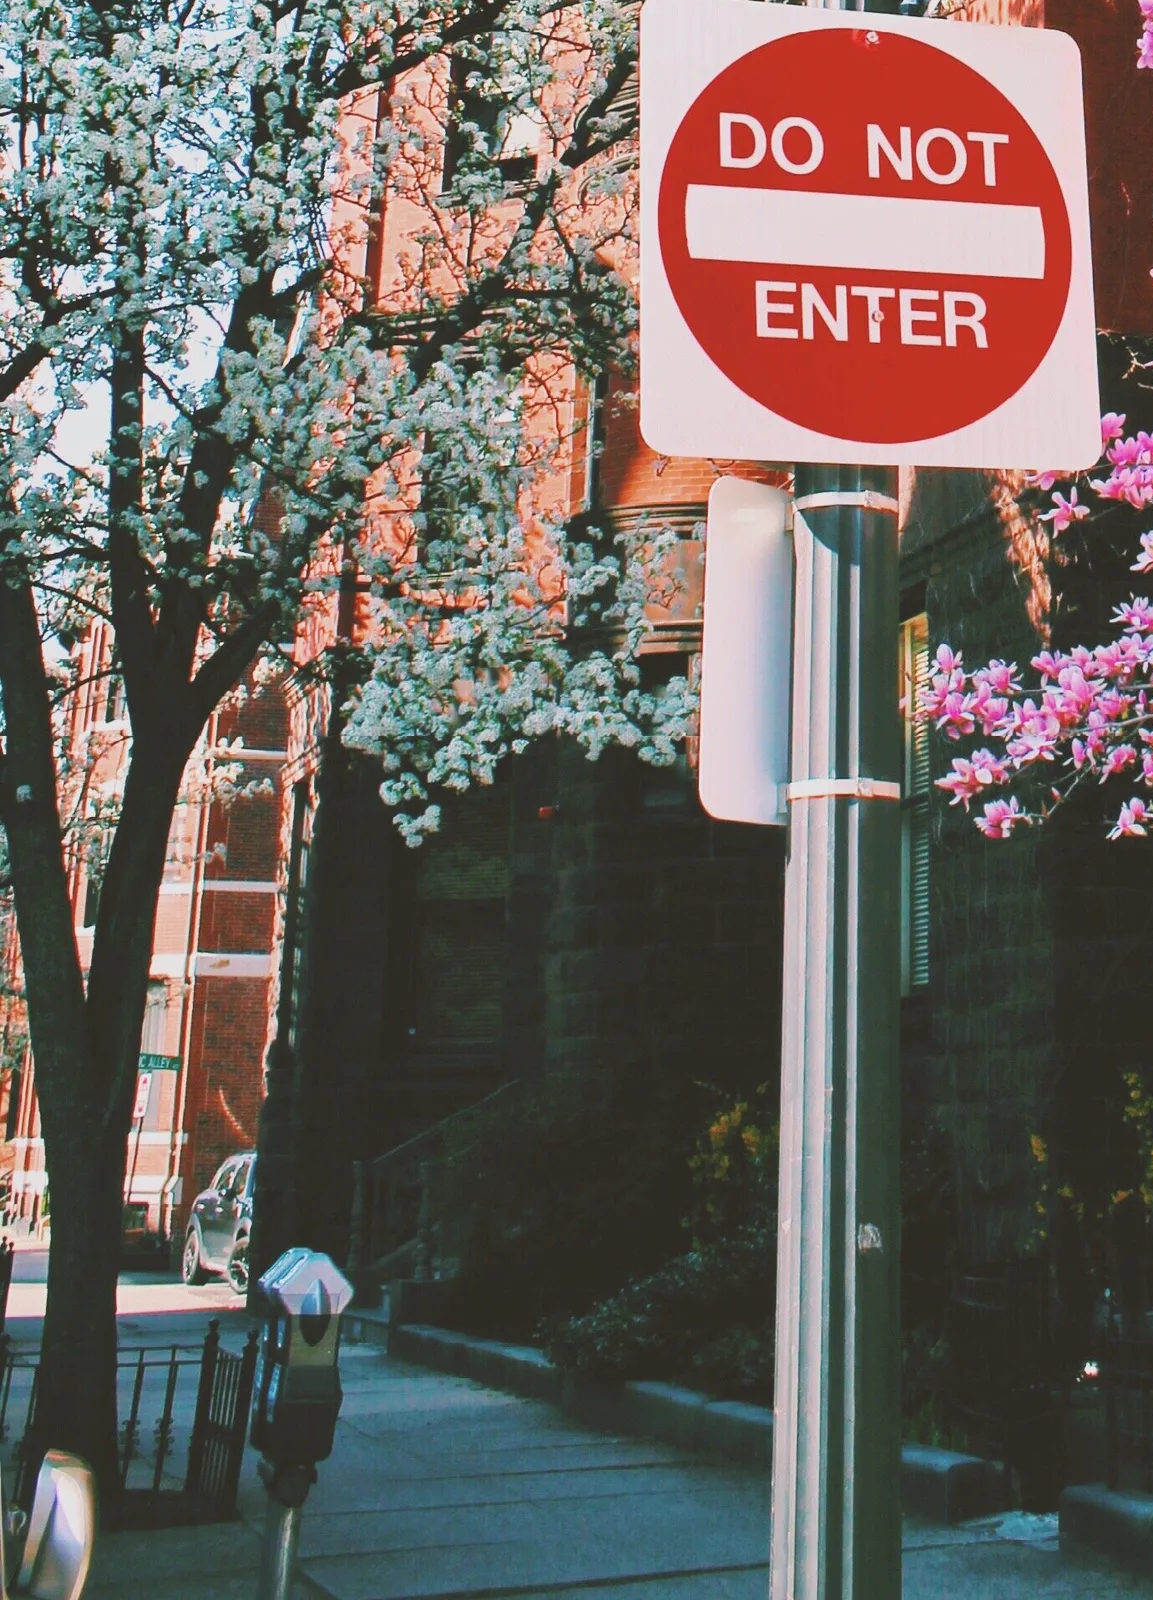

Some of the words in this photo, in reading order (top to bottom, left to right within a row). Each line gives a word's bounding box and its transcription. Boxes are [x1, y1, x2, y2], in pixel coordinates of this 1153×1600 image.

[719, 111, 824, 175] DO
[867, 123, 1009, 187] NOT
[754, 280, 989, 349] ENTER
[148, 1056, 171, 1068] ALLEY
